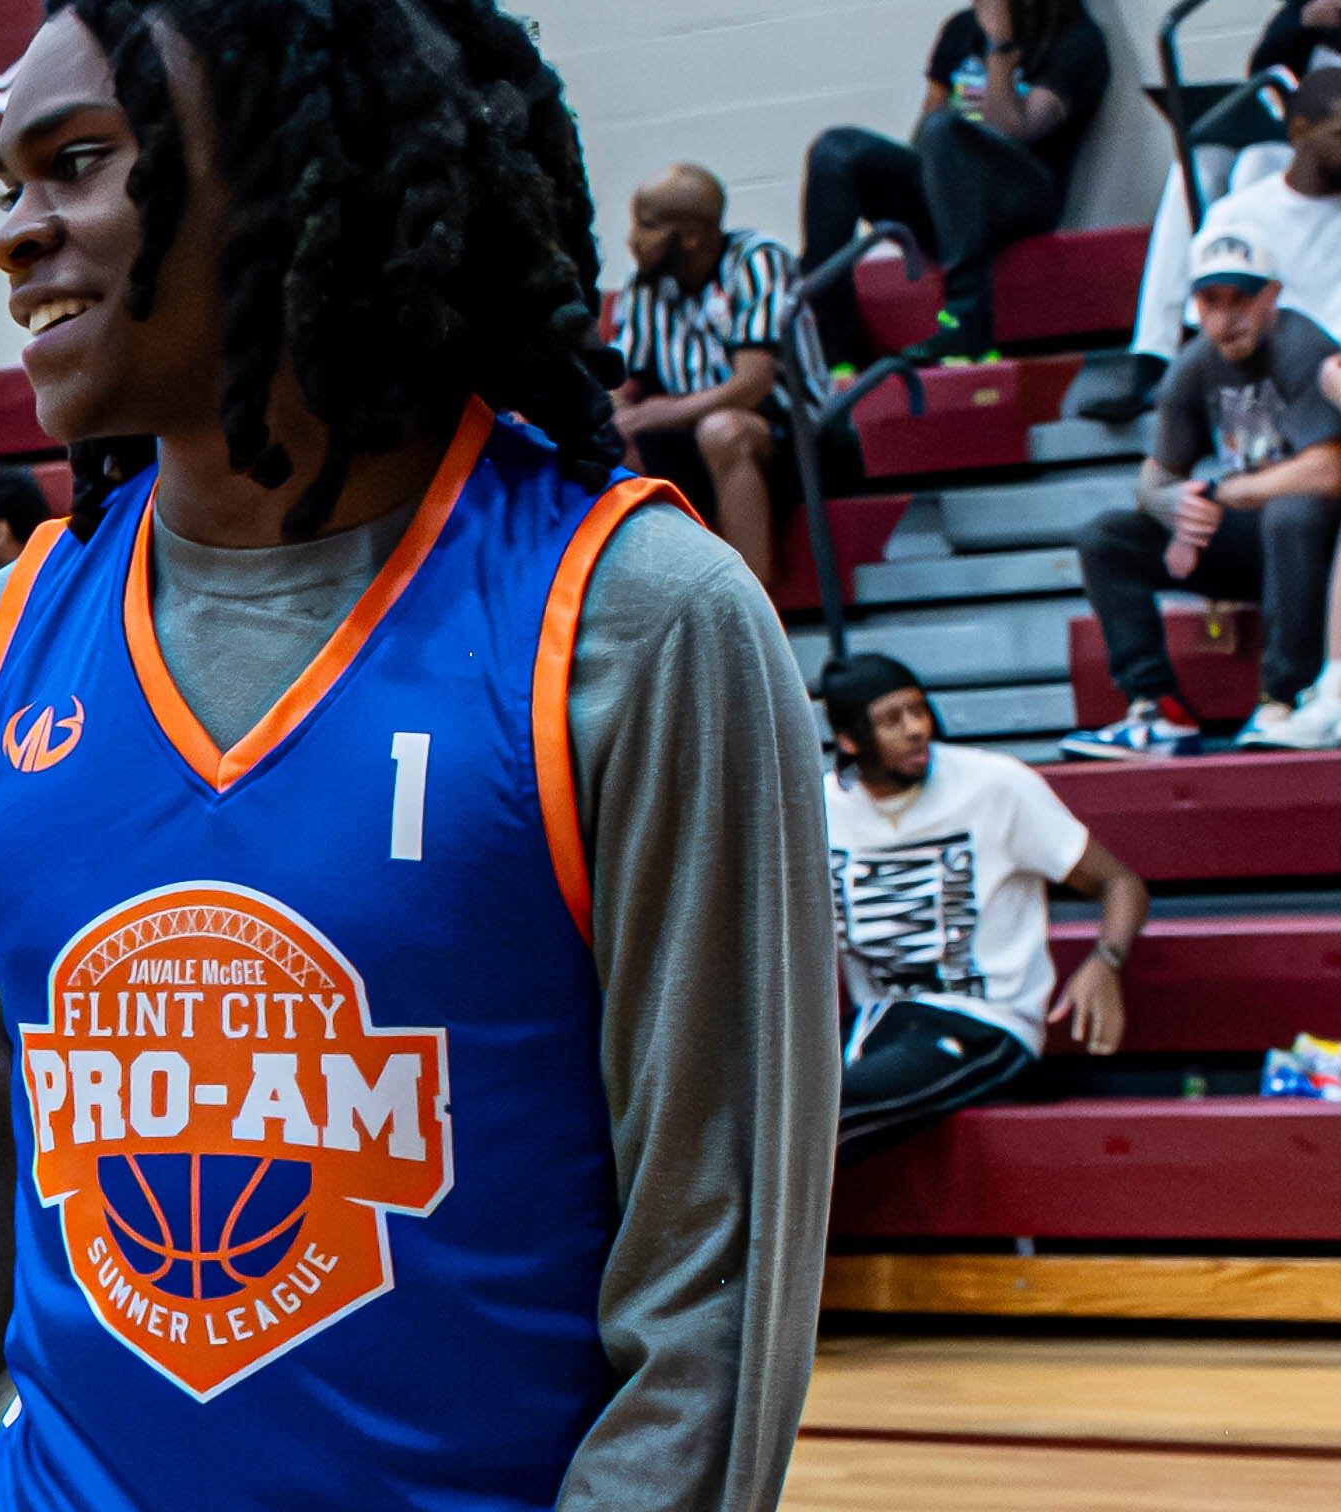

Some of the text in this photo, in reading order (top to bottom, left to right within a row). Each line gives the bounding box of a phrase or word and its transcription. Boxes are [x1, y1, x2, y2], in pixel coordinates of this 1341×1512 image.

[390, 732, 431, 861] 1
[62, 991, 346, 1039] FLINT CITY
[127, 958, 267, 986] JAVALE McGEE
[27, 1049, 427, 1162] PRO-AM
[87, 1236, 339, 1345] SUMMER LEAGUE
